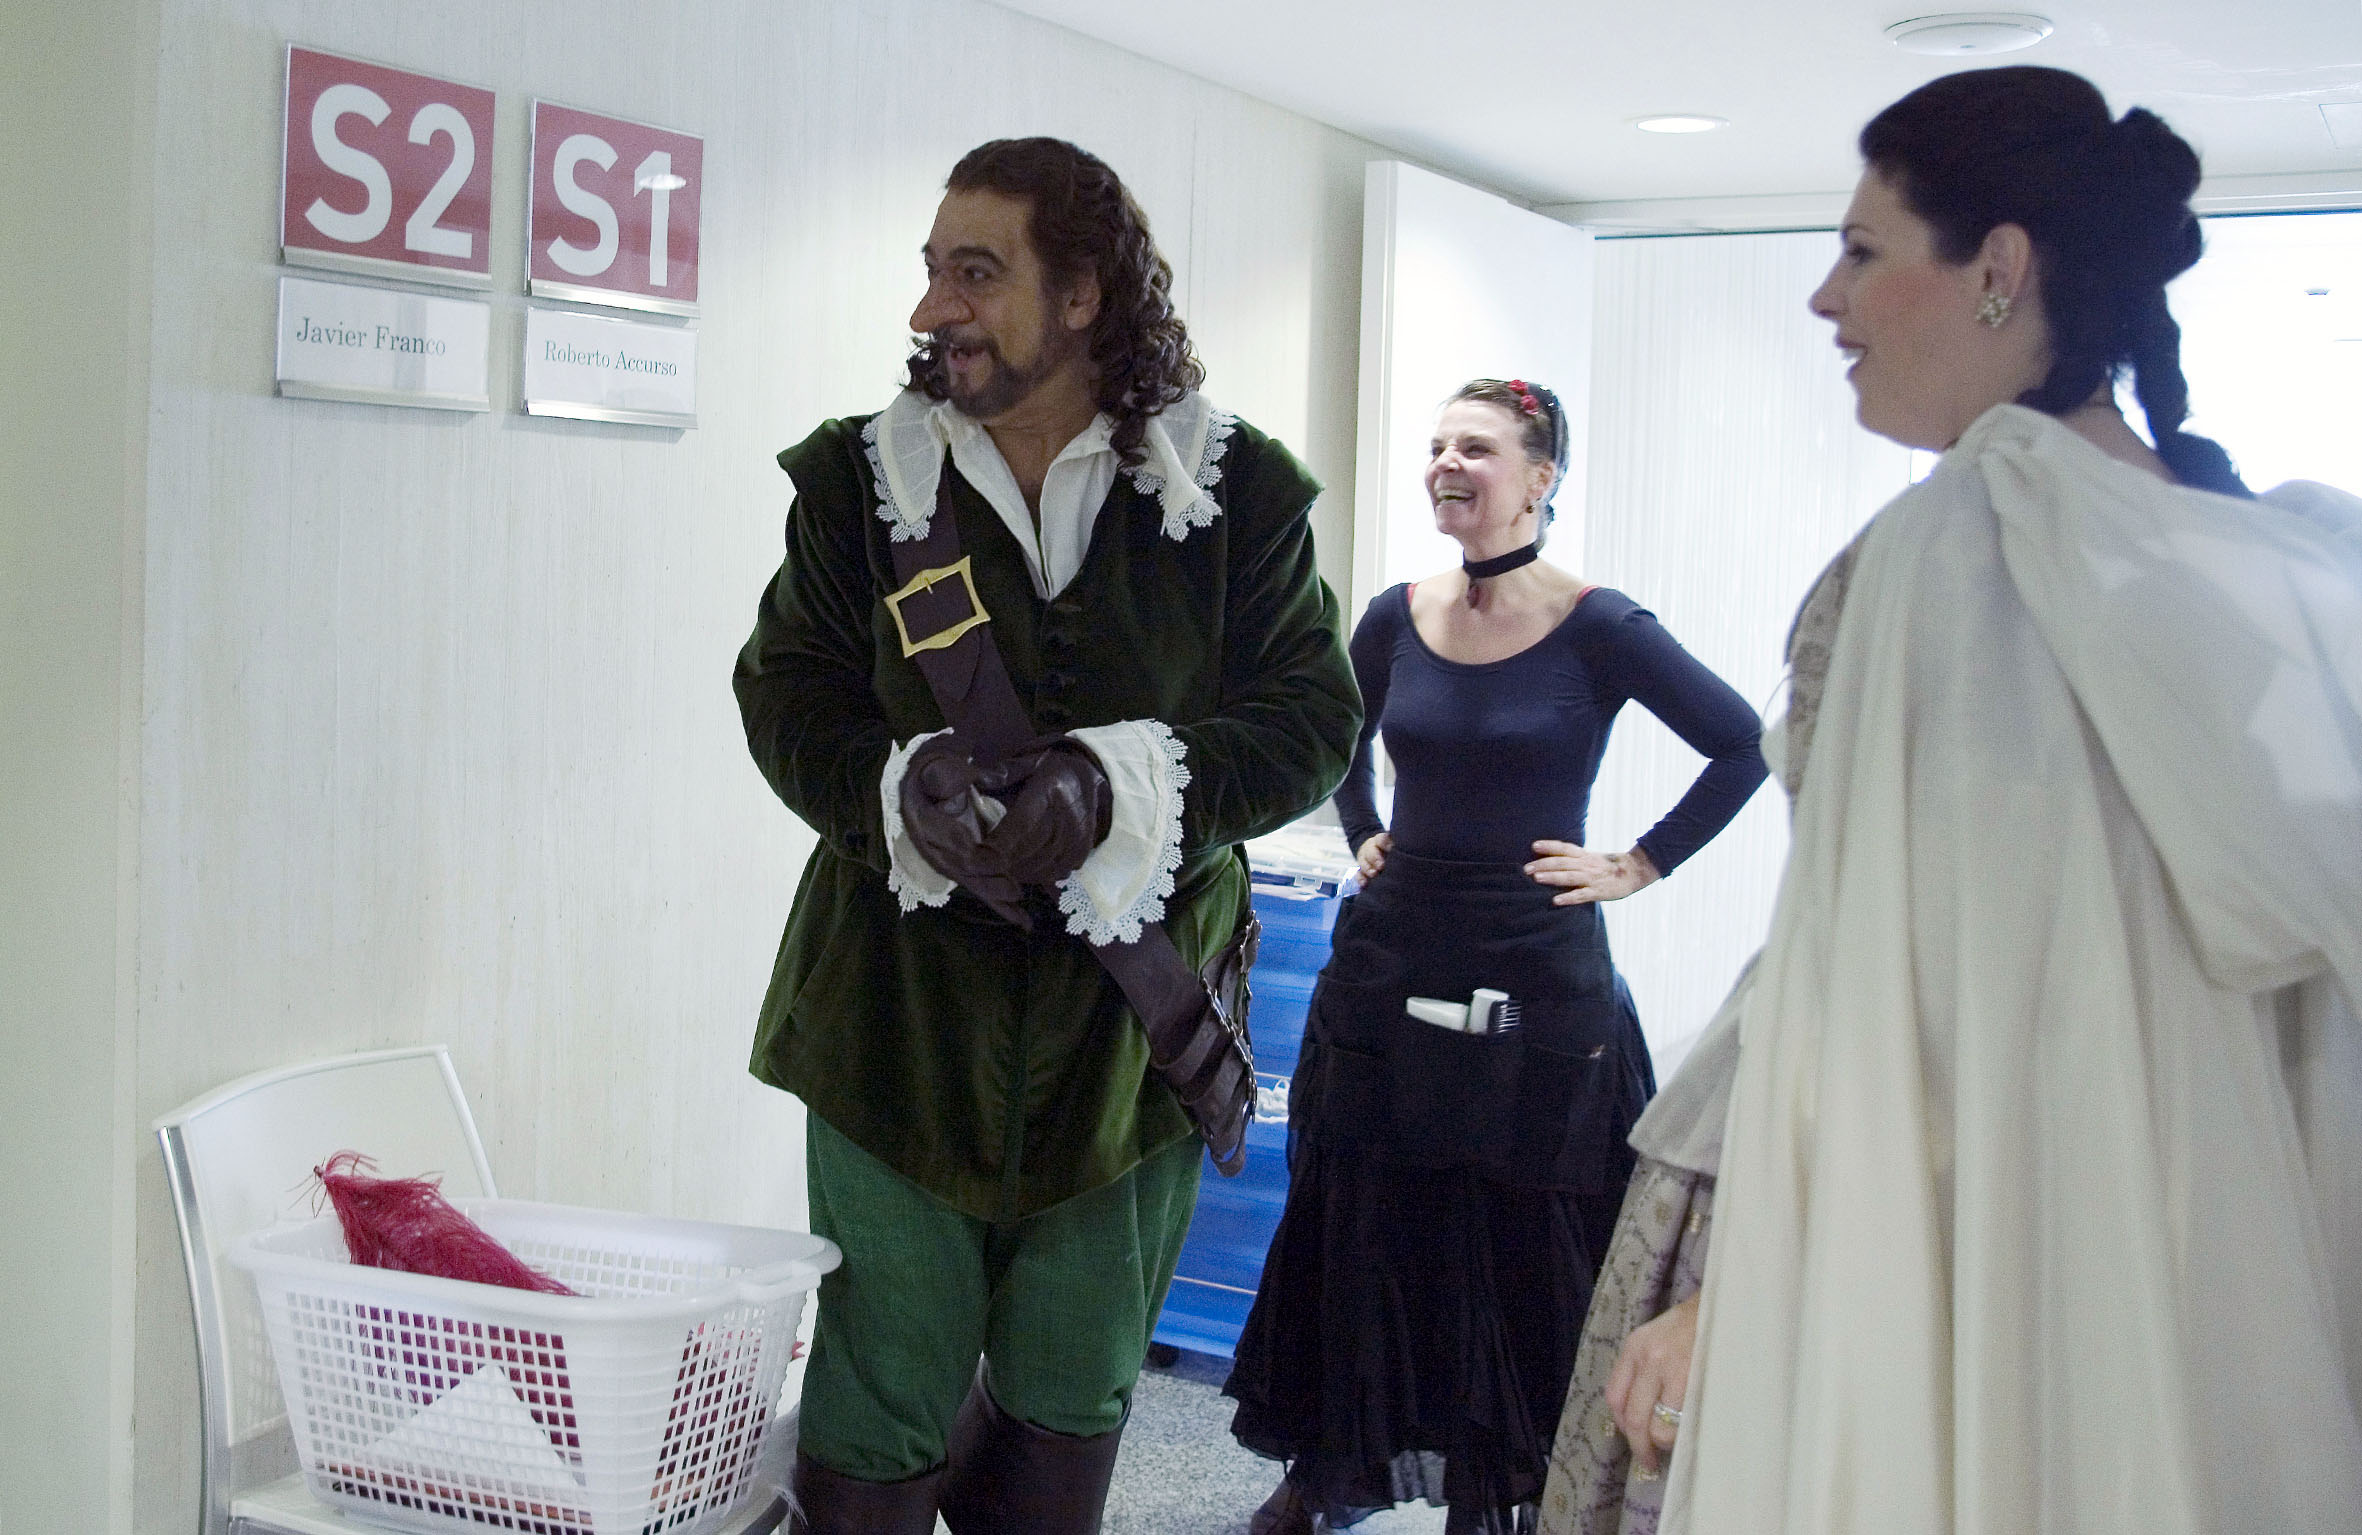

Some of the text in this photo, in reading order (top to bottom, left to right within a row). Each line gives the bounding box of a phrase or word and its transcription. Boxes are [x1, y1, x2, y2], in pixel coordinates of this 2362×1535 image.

[305, 84, 476, 259] S2
[546, 133, 672, 287] S1
[296, 317, 446, 357] Javier Franco
[544, 341, 678, 377] Roberto Accurso
